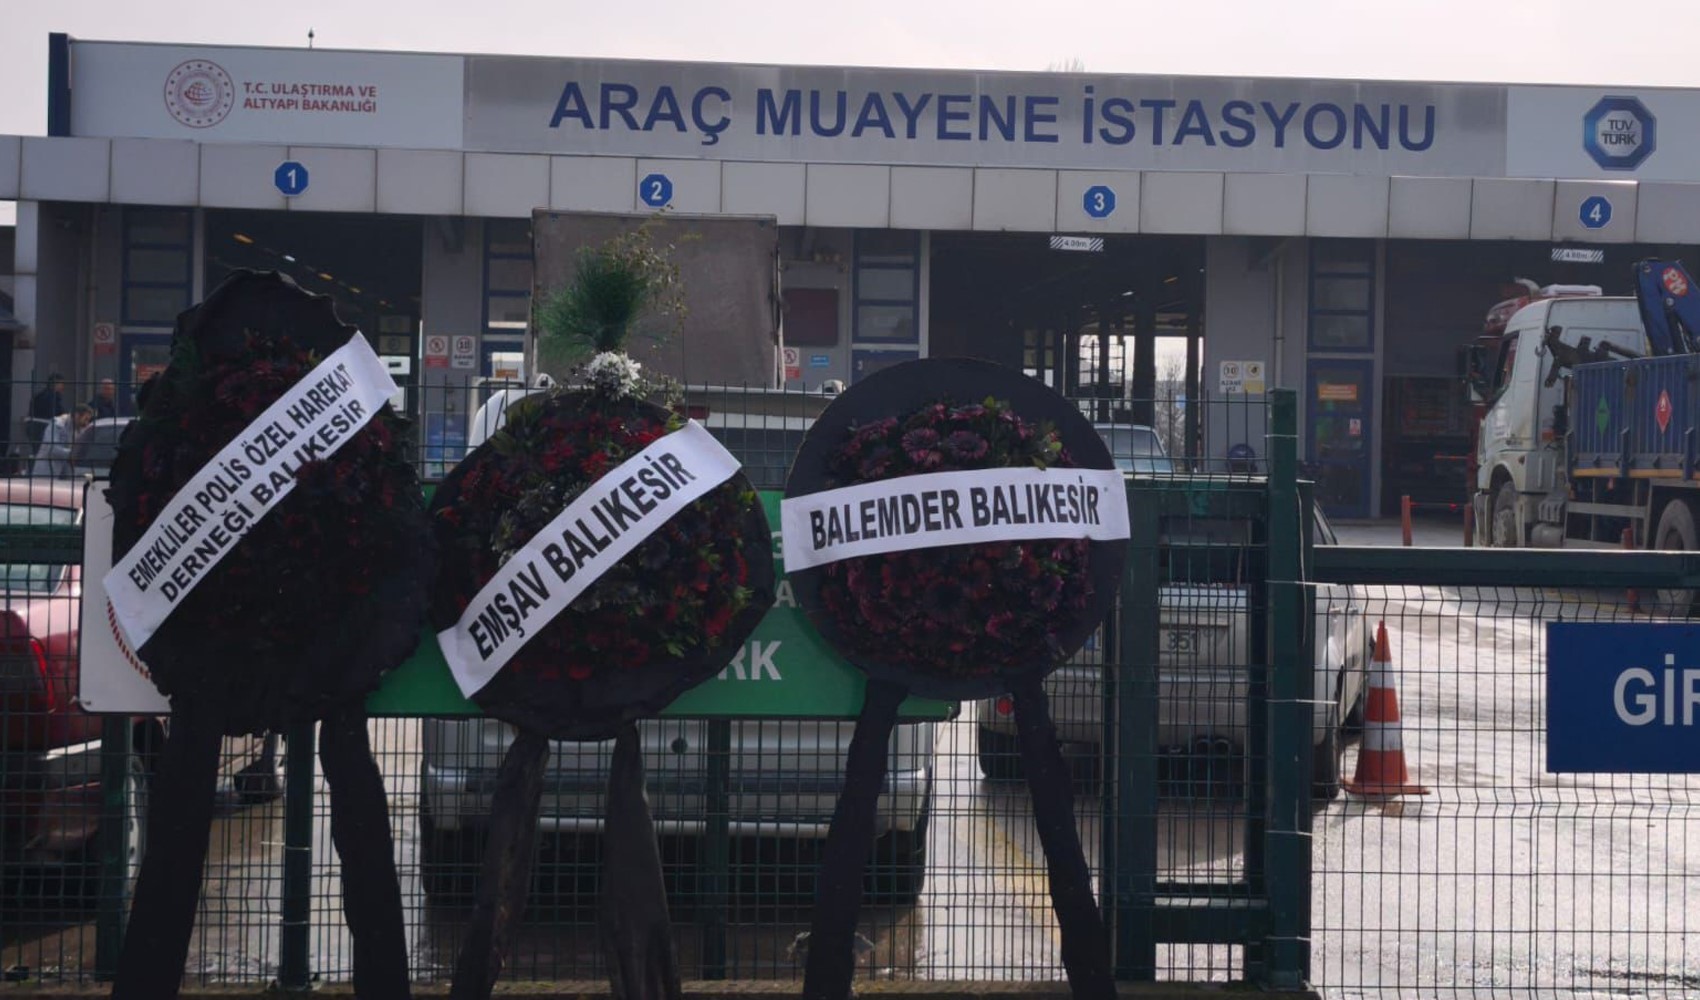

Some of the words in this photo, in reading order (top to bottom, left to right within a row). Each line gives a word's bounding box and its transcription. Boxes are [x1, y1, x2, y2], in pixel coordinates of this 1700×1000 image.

[243, 82, 268, 94] T.C.
[271, 83, 355, 98] ULAŞTIRMA
[358, 86, 377, 97] VE
[243, 98, 299, 110] ALTYAPI
[302, 98, 377, 113] BAKANLIĞI
[548, 81, 732, 146] ARAÇ
[755, 88, 1060, 143] MUAYENE
[1082, 85, 1436, 152] İSTASYONU
[287, 169, 296, 189] 1
[651, 181, 663, 200] 2
[1094, 192, 1105, 211] 3
[1589, 203, 1602, 222] 4
[128, 504, 207, 592] EMEKLİLER
[194, 457, 251, 514] POLİS
[241, 421, 297, 466] ÖZEL
[286, 363, 355, 430] HAREKAT
[160, 499, 255, 603] DERNEĞİ
[250, 399, 367, 506] BALIKESİR
[810, 488, 964, 550] BALEMDER
[970, 475, 1100, 527] BALIKESİR
[468, 561, 551, 661] EMŞAV
[541, 452, 697, 583] BALIKESİR
